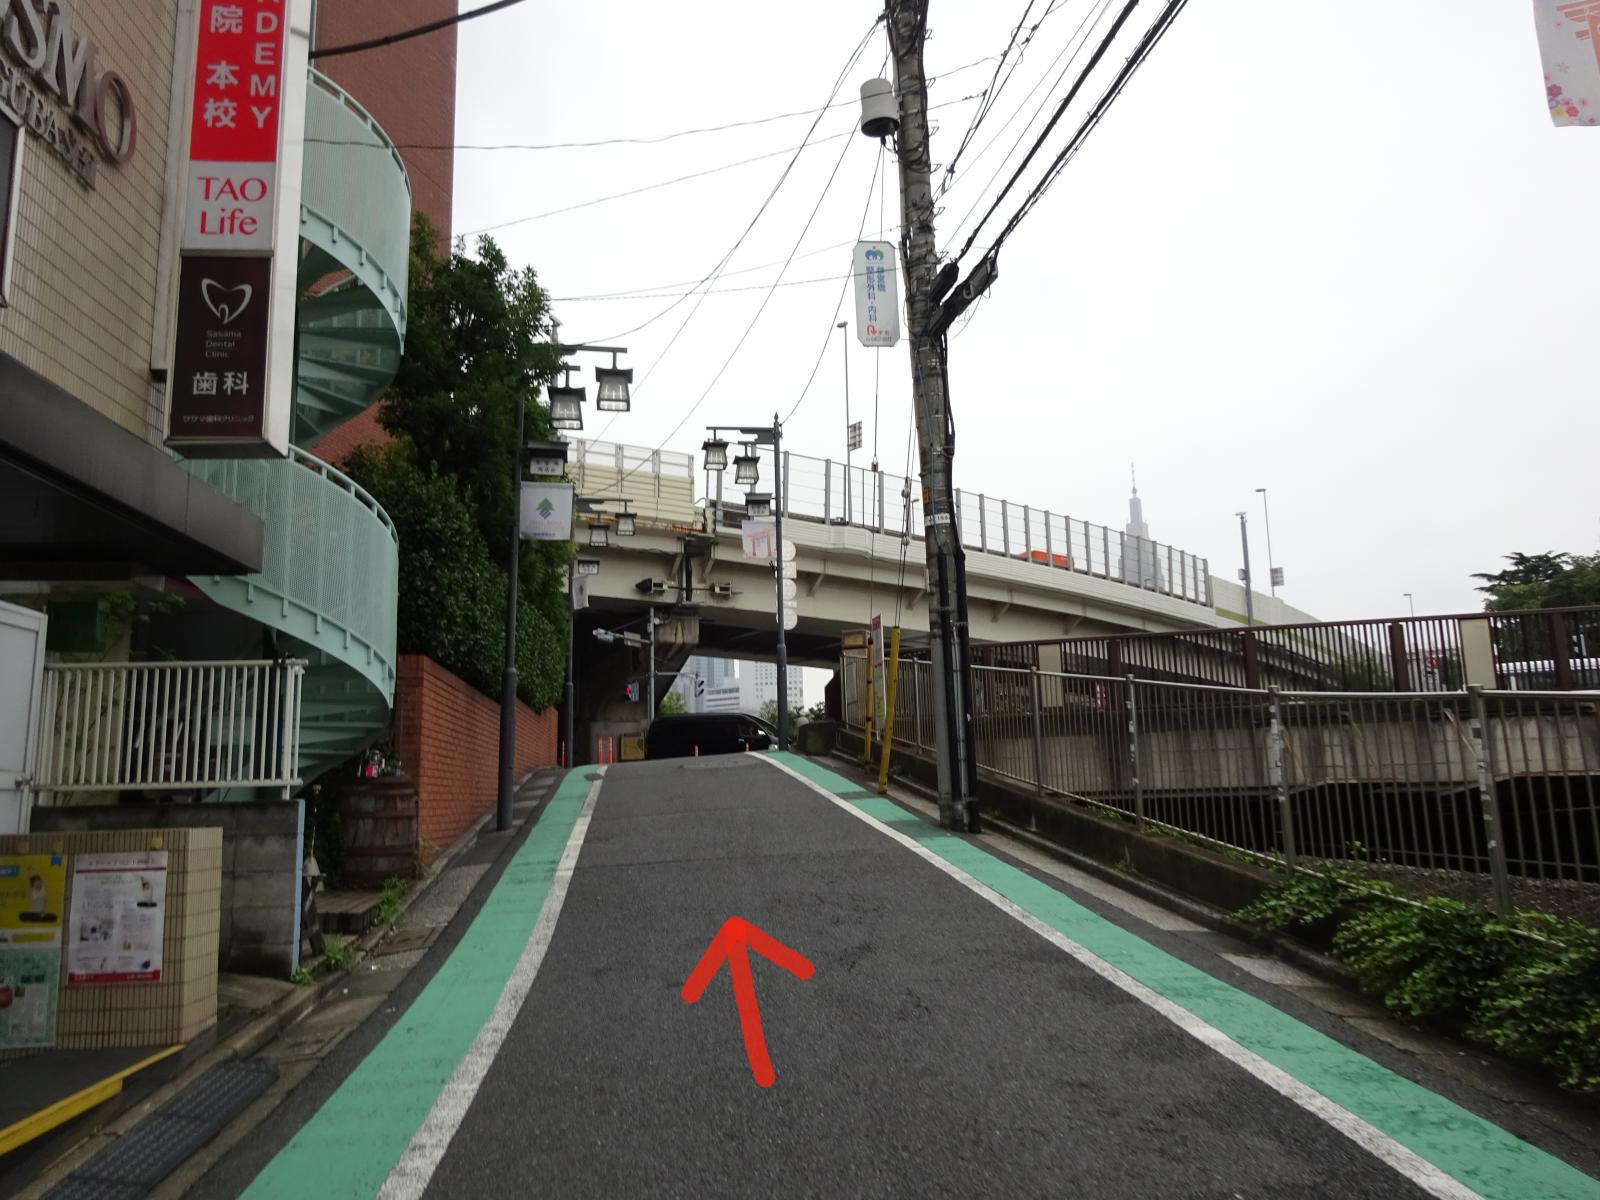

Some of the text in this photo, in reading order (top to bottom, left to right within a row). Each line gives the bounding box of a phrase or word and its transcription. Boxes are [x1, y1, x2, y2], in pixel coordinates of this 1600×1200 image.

[249, 0, 280, 129] DEMY
[0, 0, 138, 166] SMO
[197, 176, 268, 203] TAO
[199, 207, 258, 236] Life
[204, 350, 230, 358] Clinic
[205, 339, 235, 348] Dental
[192, 371, 249, 395] 歯科
